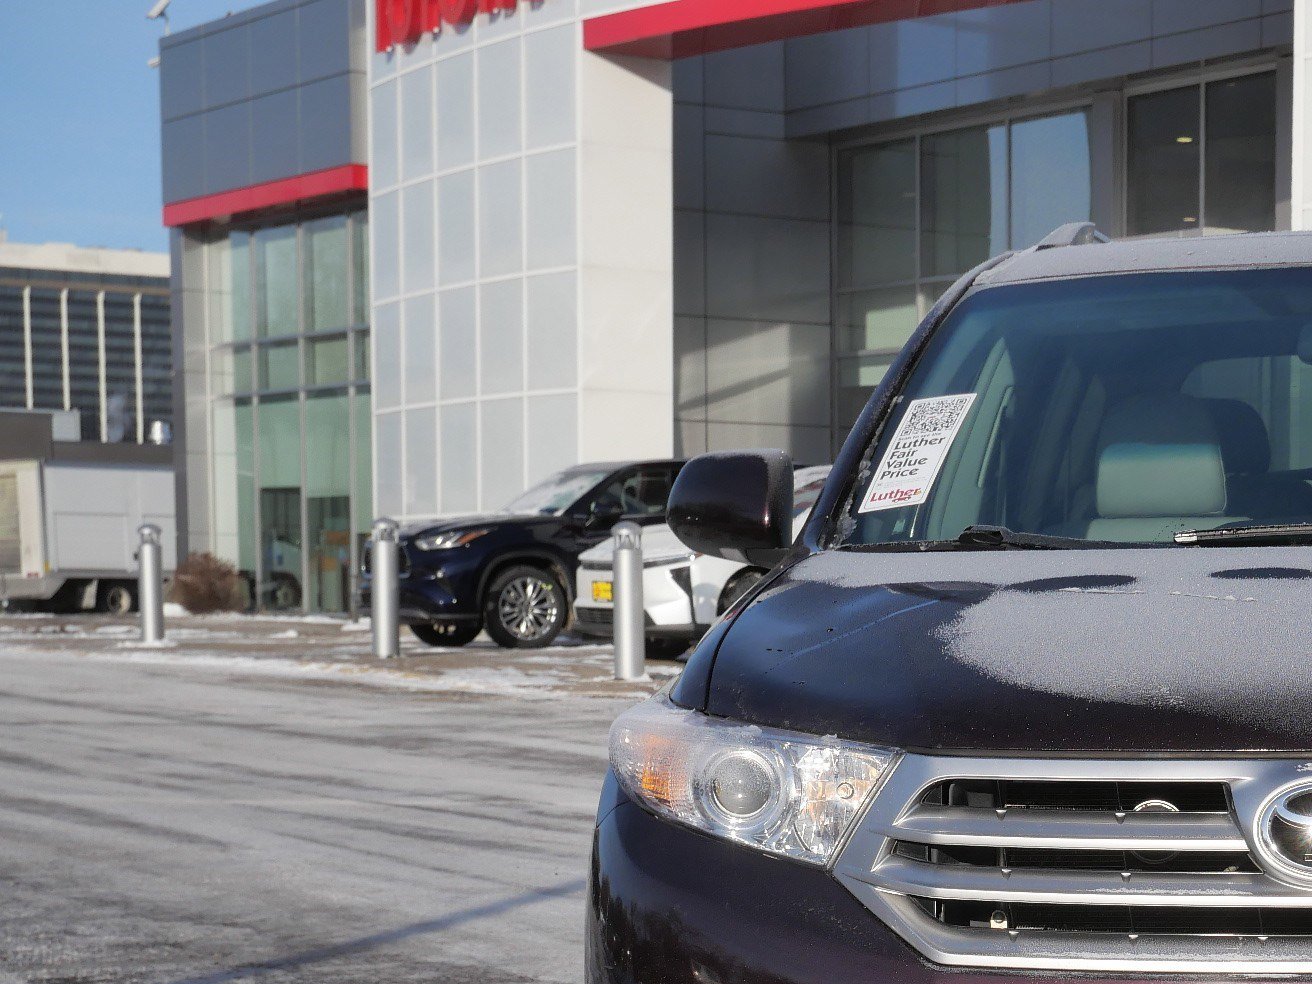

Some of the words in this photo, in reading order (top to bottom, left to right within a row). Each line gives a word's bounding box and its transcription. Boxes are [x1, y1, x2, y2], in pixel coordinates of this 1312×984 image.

[893, 437, 946, 450] Luther
[890, 448, 918, 460] Fair
[886, 457, 928, 470] Value
[880, 469, 920, 481] Price
[870, 487, 922, 503] Luther
